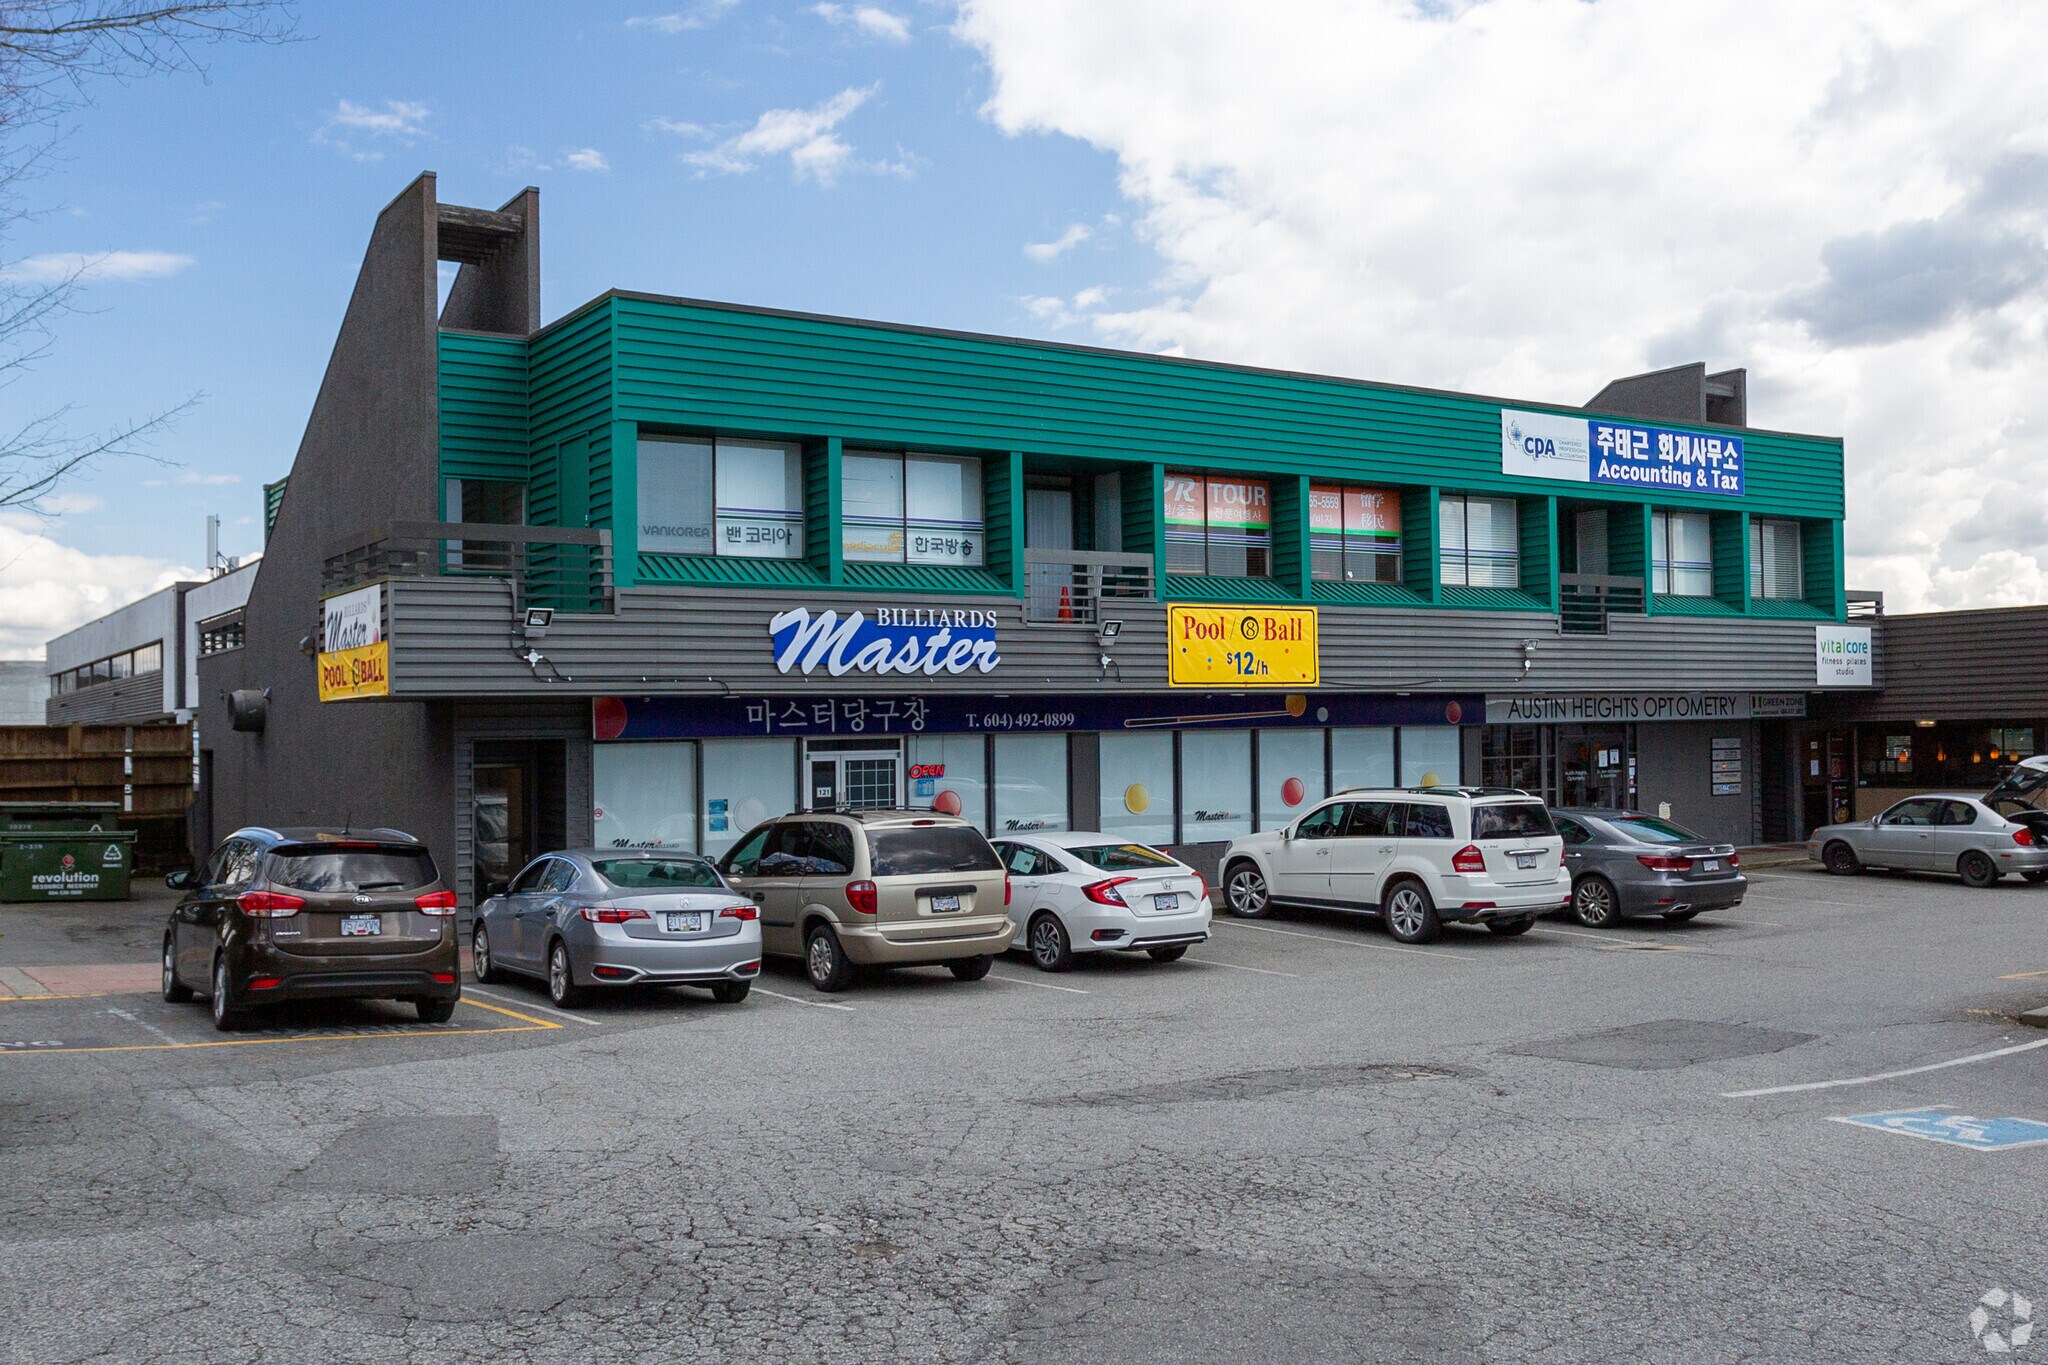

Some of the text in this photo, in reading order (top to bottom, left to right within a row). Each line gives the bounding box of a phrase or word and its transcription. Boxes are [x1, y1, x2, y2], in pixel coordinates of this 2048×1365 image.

[1597, 426, 1739, 471] 주태근 회계사무소
[1597, 458, 1739, 491] Accounting & Tax
[1209, 482, 1267, 507] TOUR
[1360, 512, 1385, 529] 移民
[642, 525, 711, 538] VANKOREA
[726, 525, 793, 545] 밴 코리아
[914, 535, 974, 556] 한국방송
[876, 607, 998, 629] BILLIARDS
[1183, 615, 1226, 641] Pool
[1263, 617, 1303, 641] Ball
[327, 611, 367, 652] Master
[769, 607, 1001, 677] Master
[1820, 638, 1868, 654] vitalcore
[1226, 650, 1269, 676] $12/h
[1821, 656, 1843, 665] fitness
[325, 665, 347, 690] POOL
[361, 658, 384, 683] BALL
[1835, 667, 1855, 676] studio
[745, 698, 930, 734] 마스터당구장
[1508, 695, 1737, 719] AUSTIN HEIGHTS OPTOMETRY
[965, 713, 979, 728] T.
[909, 764, 945, 779] OPEN
[1005, 819, 1040, 831] Master
[1195, 810, 1225, 821] Master
[612, 838, 657, 850] Master
[32, 871, 100, 883] revolution
